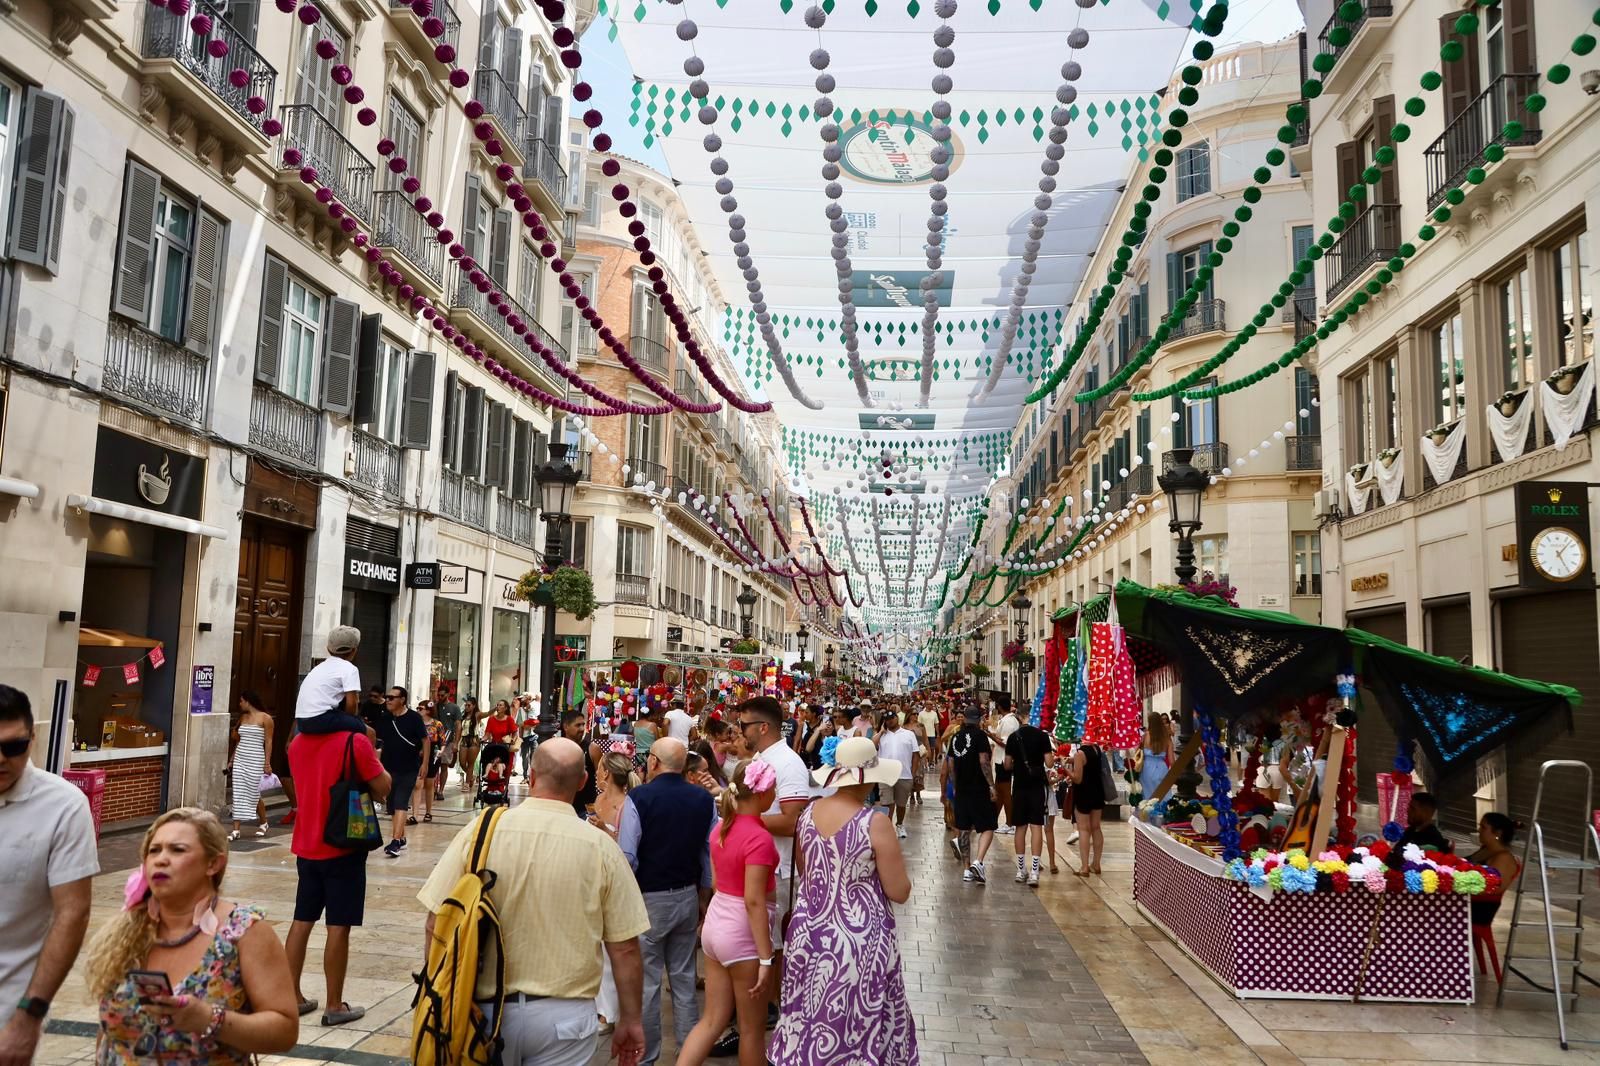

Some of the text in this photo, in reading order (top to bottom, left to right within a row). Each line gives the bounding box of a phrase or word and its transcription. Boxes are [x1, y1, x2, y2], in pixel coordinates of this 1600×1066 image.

[1531, 505, 1579, 515] ROLEX
[350, 559, 398, 582] EXCHANGE
[442, 574, 464, 582] Etam
[195, 670, 213, 680] libre
